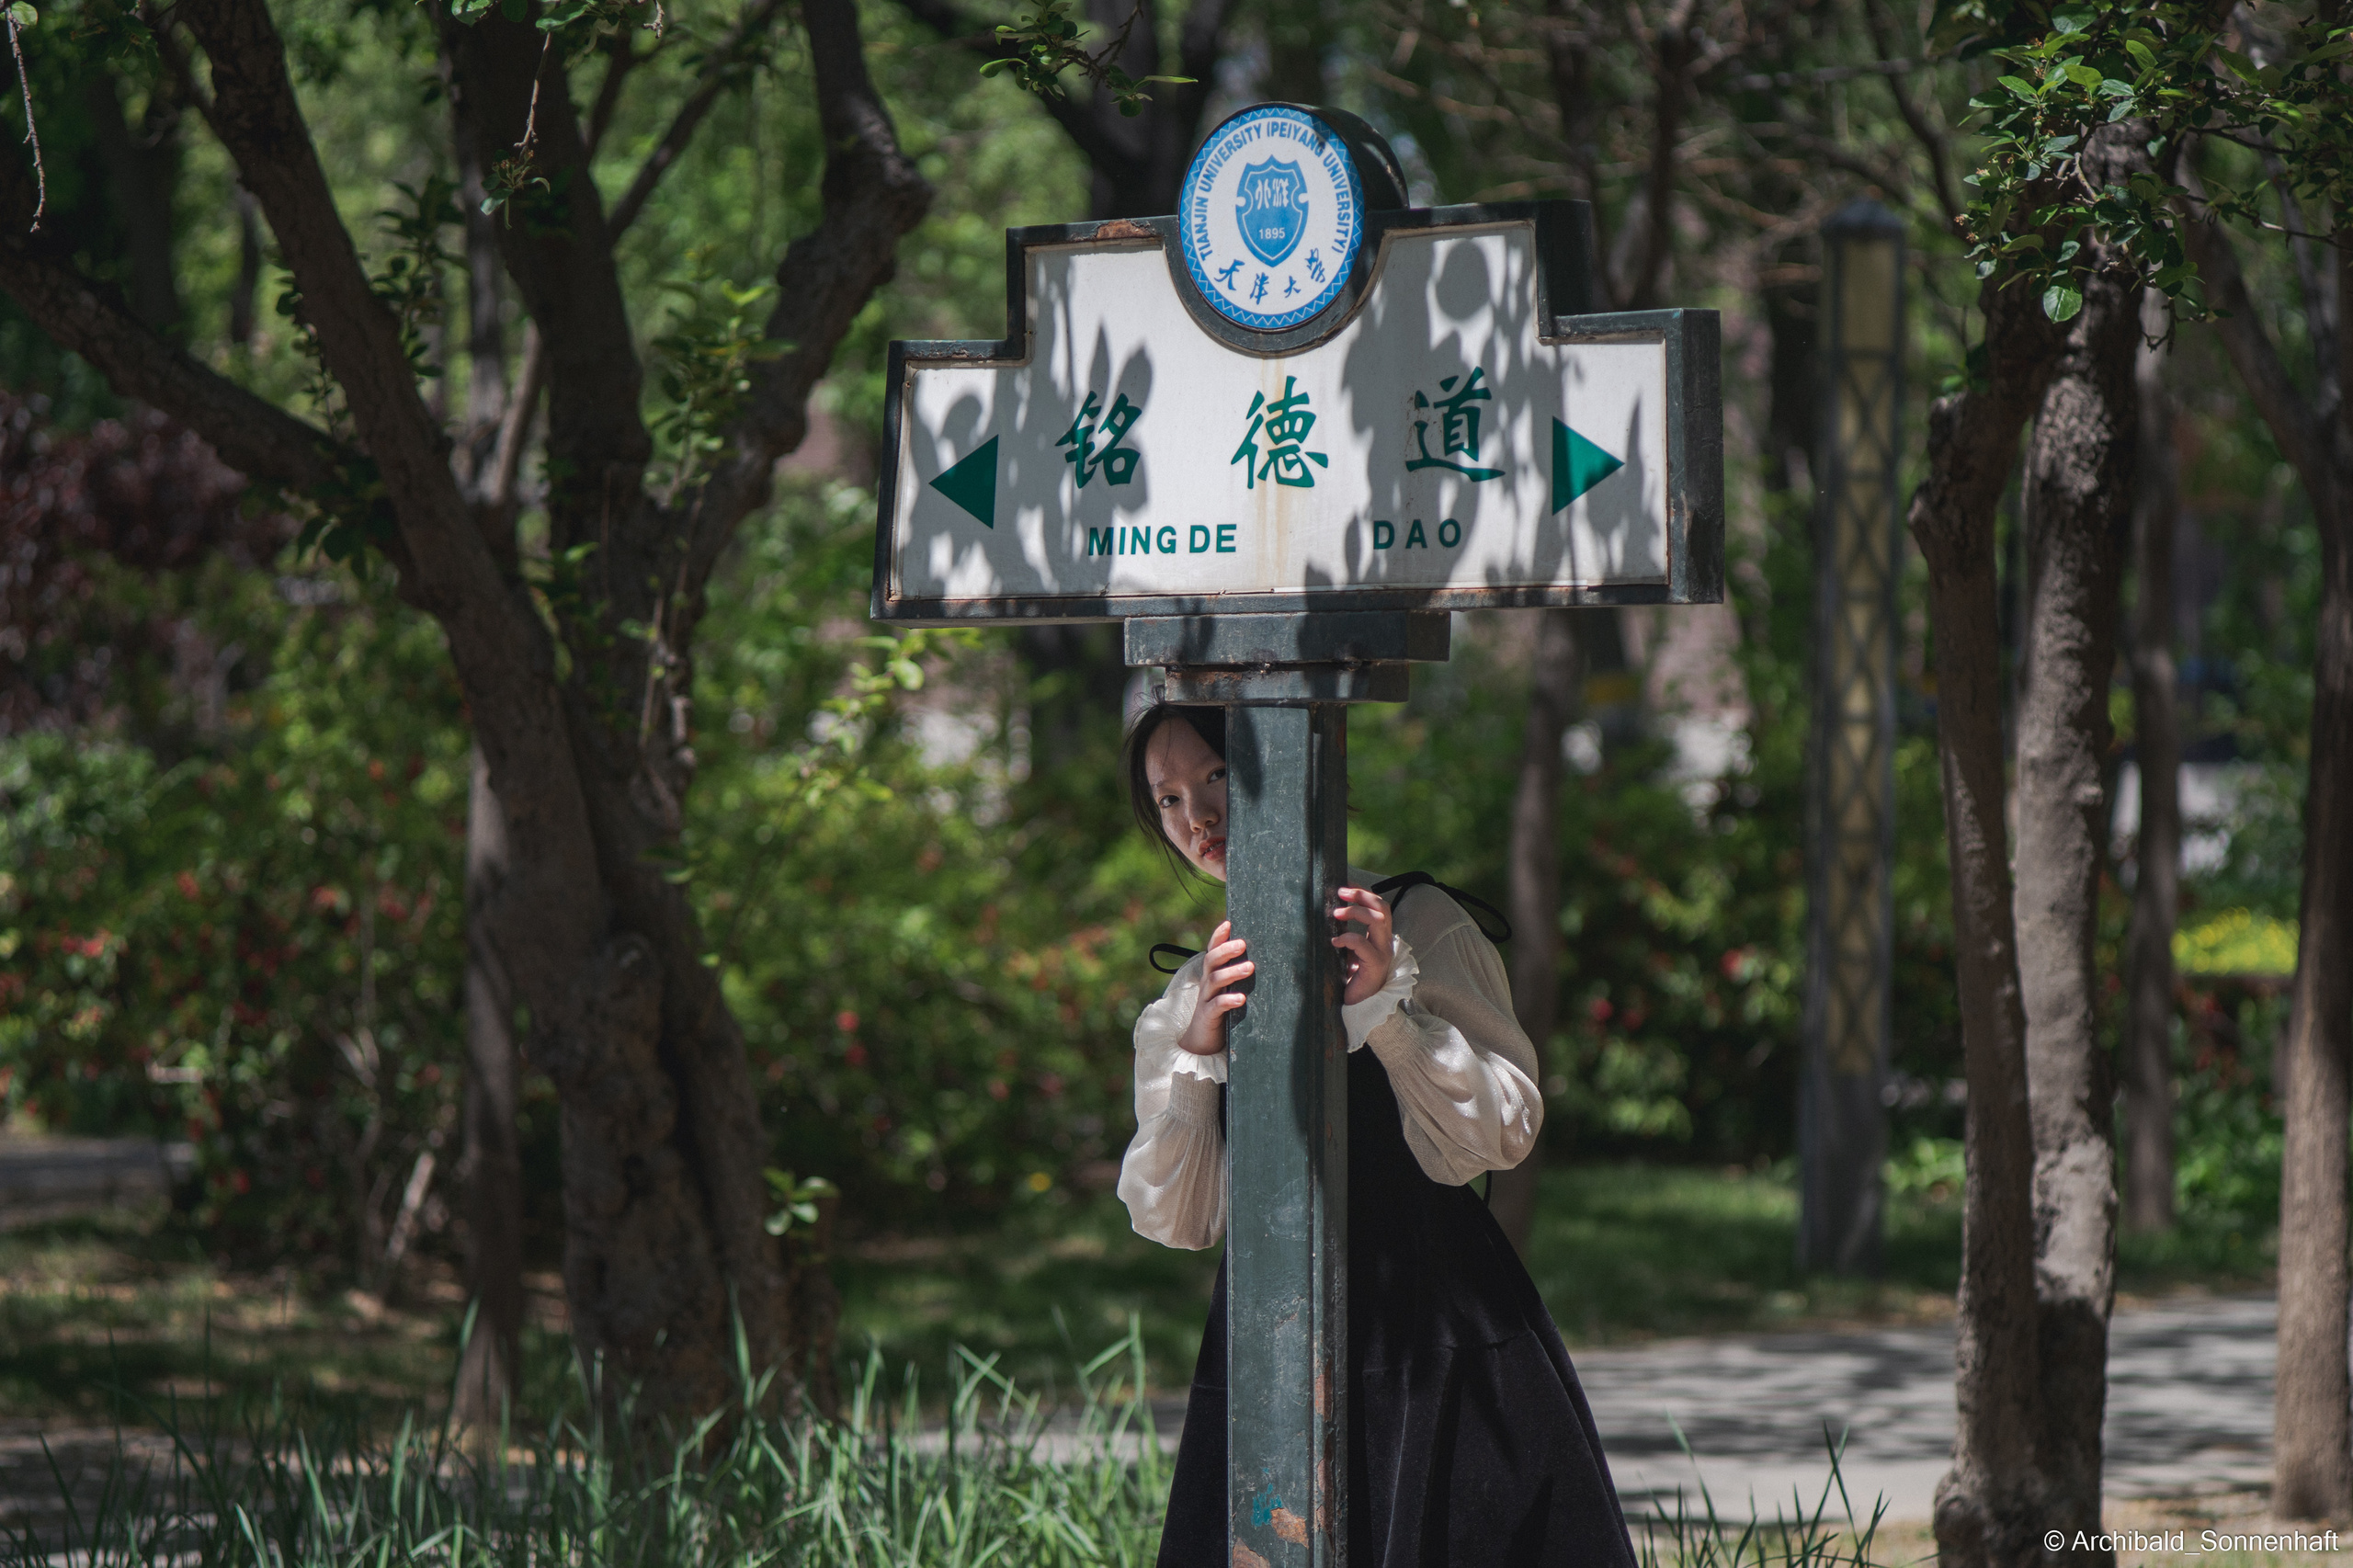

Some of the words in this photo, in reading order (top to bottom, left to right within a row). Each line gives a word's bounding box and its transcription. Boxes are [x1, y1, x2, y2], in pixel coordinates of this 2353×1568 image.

[1199, 122, 1263, 192] UNIVERSITY
[1266, 120, 1326, 158] (PEIYANG
[1194, 196, 1214, 262] TIANJIN
[1258, 227, 1286, 240] 1895
[1323, 156, 1351, 254] UNIVERSITY)
[1054, 366, 1506, 490] 铭德道
[1372, 518, 1462, 551] DAO
